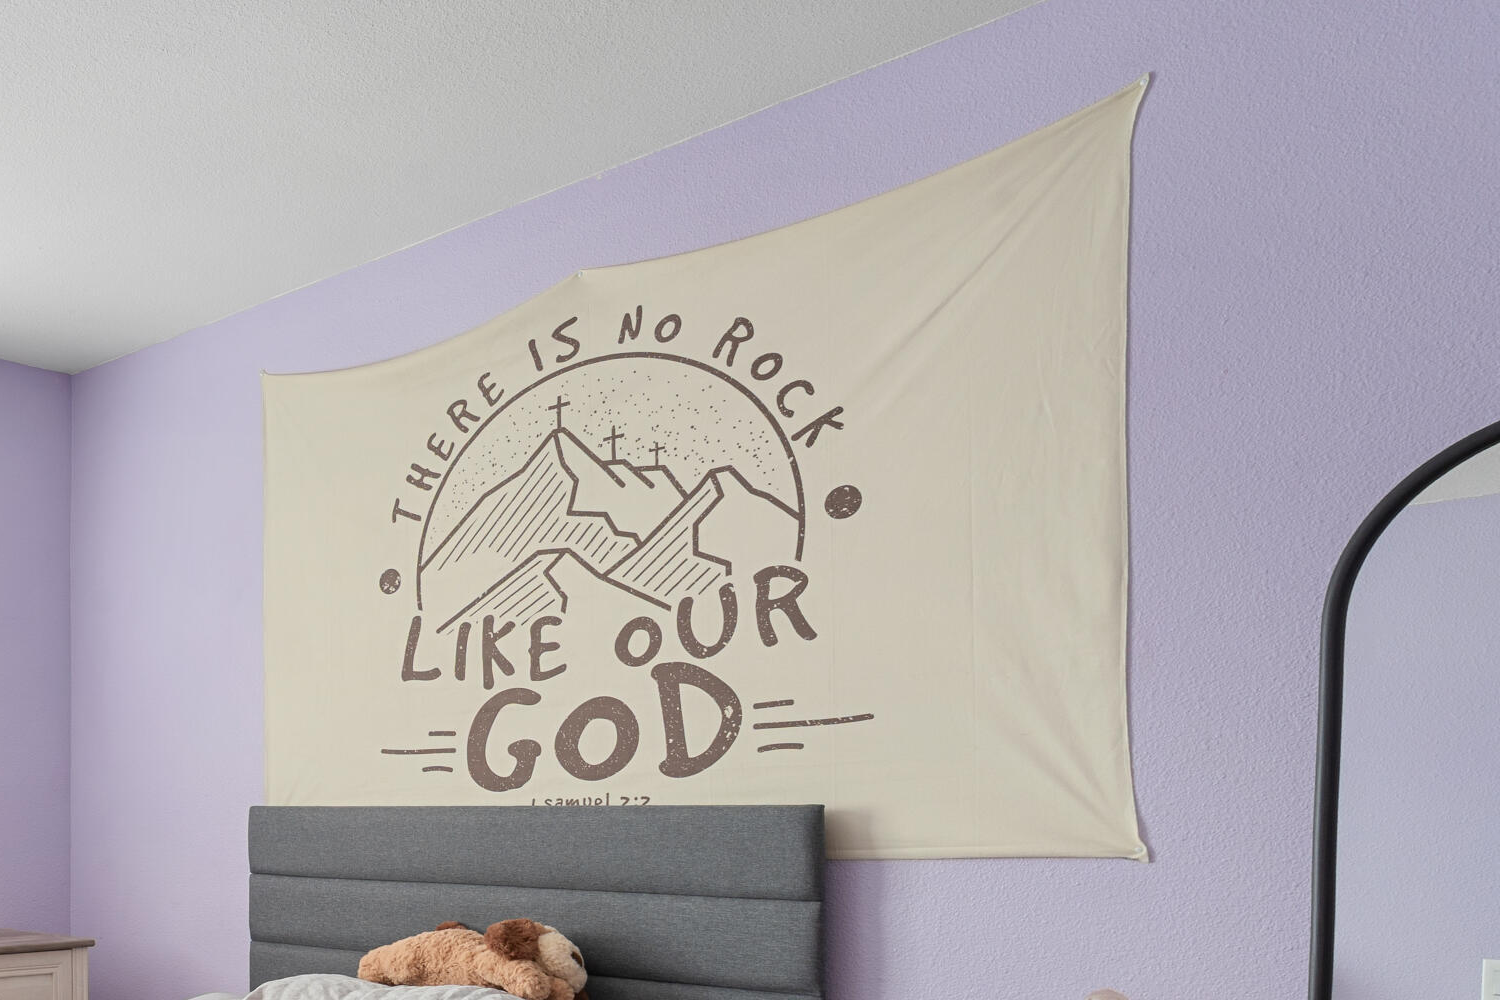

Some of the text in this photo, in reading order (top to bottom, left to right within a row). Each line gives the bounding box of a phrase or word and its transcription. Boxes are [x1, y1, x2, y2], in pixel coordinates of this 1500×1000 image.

[391, 304, 845, 524] THERE IS NO ROCK
[400, 564, 818, 690] LIKE OUR
[466, 662, 743, 792] GOD
